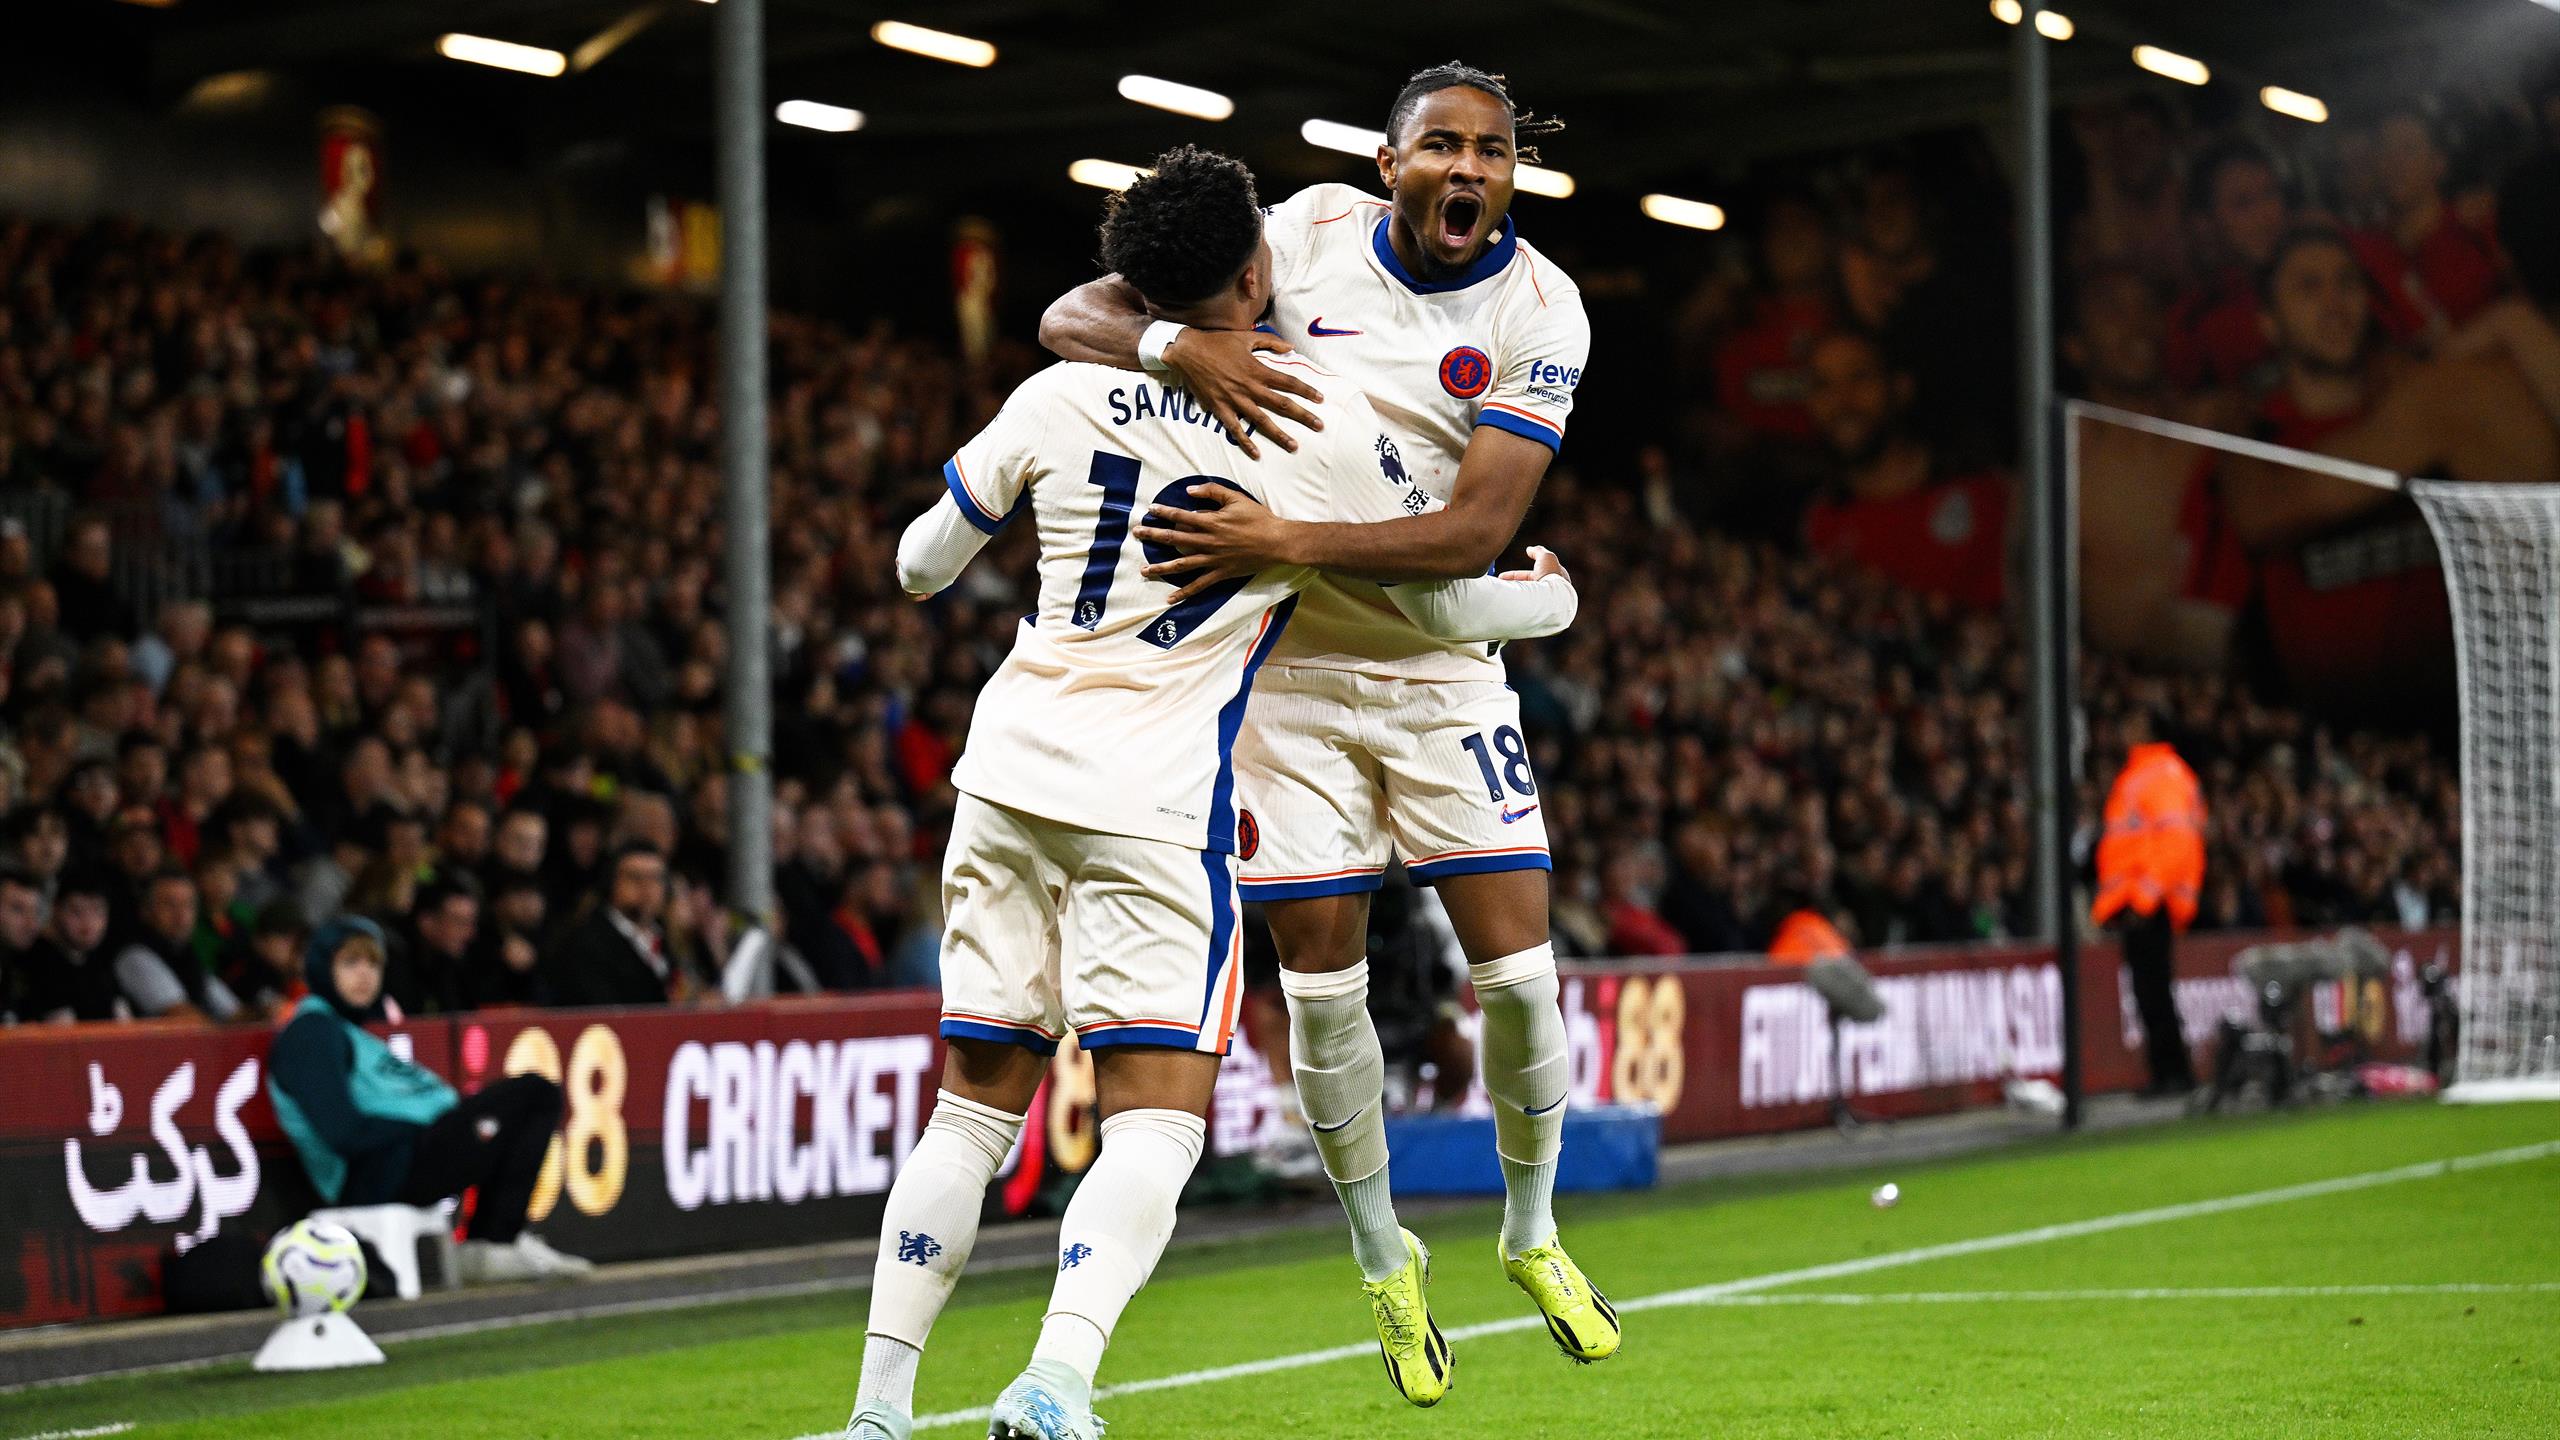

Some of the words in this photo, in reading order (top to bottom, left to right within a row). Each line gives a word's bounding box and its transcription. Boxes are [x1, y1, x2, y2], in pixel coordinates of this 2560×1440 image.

[1530, 360, 1580, 386] feve
[1460, 724, 1535, 802] 18
[662, 1033, 933, 1212] CRICKET
